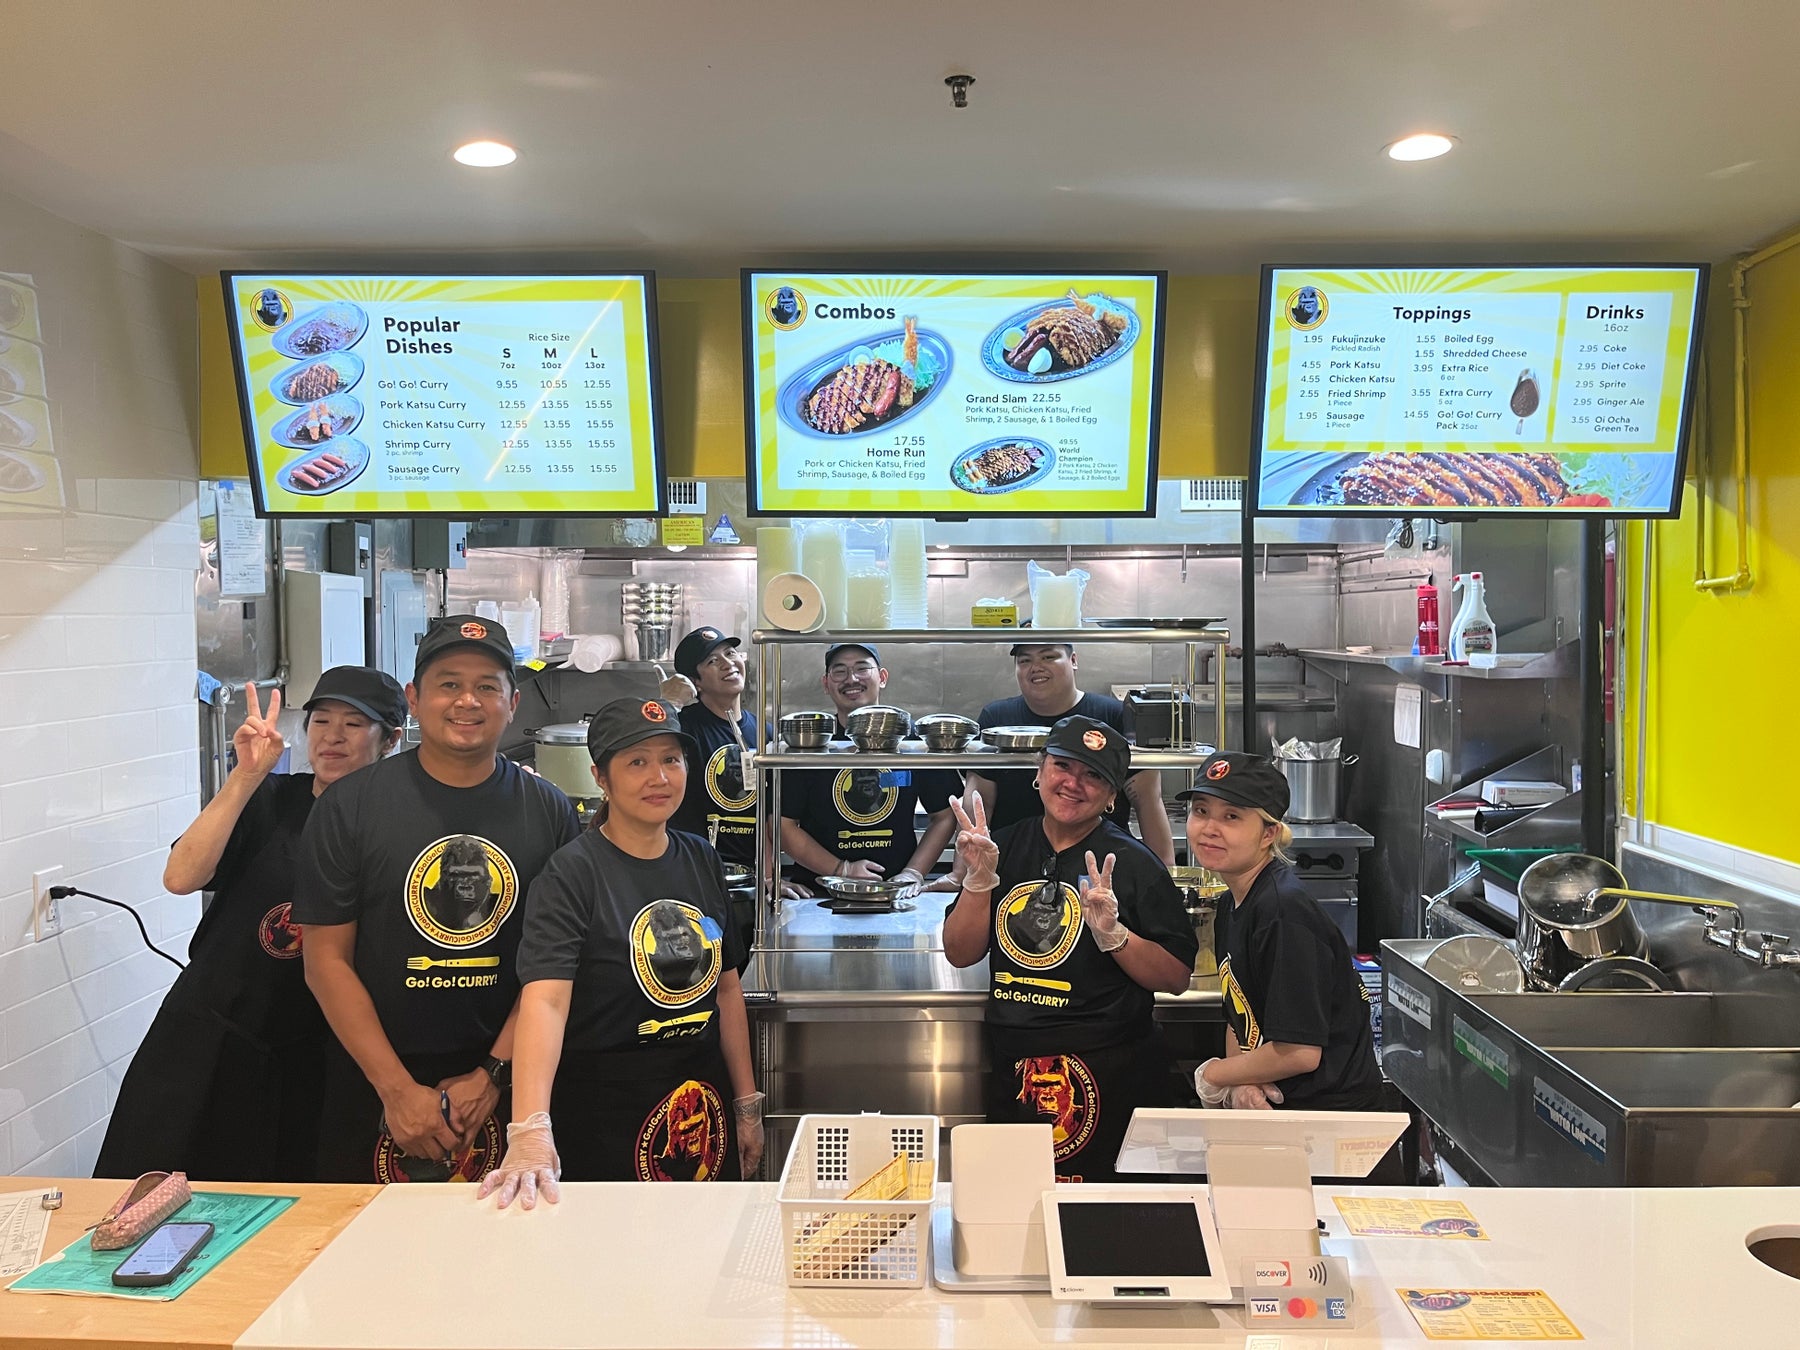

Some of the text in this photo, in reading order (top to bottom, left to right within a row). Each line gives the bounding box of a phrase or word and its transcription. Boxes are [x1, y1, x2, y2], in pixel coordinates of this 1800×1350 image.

[814, 303, 895, 319] Combos
[1393, 306, 1471, 323] Toppings
[1586, 305, 1644, 319] Drinks
[384, 316, 460, 335] Popular
[1604, 323, 1629, 332] 16oz
[528, 333, 570, 341] Rice Size
[1304, 335, 1386, 345] 1.95 Fukujinzuke
[1416, 334, 1494, 345] 1.55 Boiled Egg
[386, 338, 453, 354] Dishes
[503, 348, 598, 358] S M L
[1415, 349, 1527, 358] 1.55 Shredded Cheese
[1330, 360, 1351, 369] Pork
[1413, 364, 1433, 372] 3.95
[1468, 364, 1489, 372] Rice
[1601, 362, 1620, 370] Diet
[1300, 375, 1320, 383] 4.55
[1329, 374, 1366, 383] Chicken
[378, 380, 611, 391] Go! Go! Curry 9.55 10.55 12.55
[1575, 380, 1626, 390] 2.95 Sprite
[966, 393, 1061, 403] Grand Slam 22.55
[1300, 389, 1386, 399] 2.55 Fried Shrimp
[1411, 388, 1493, 398] 3.55 Extra Curry
[380, 400, 613, 411] Pork Katsu Curry 12.55 13.55 15.55
[1597, 398, 1627, 408] Ginger
[986, 406, 1010, 414] Katsu,
[1012, 405, 1044, 414] Chicken
[1045, 406, 1070, 414] Katsu,
[1082, 415, 1098, 425] Egg
[1326, 412, 1365, 422] Sausage
[1404, 410, 1502, 420] 14.55 Go! Go! Curry
[382, 420, 614, 430] Chicken Katsu Curry 12.55 13.55 15.55
[1436, 421, 1458, 430] Pack
[385, 439, 615, 450] Shrimp Curry 12.55 13.55 15.55
[894, 436, 925, 446] 17.55
[867, 448, 925, 457] Home Run
[805, 459, 824, 468] Pork
[838, 459, 873, 468] Chicken
[875, 460, 902, 469] Katsu,
[903, 460, 926, 468] Fried
[388, 464, 617, 475] Sausage Curry 12.55 13.55 15.55
[797, 469, 830, 479] Shrimp,
[831, 470, 869, 480] Sausage,
[880, 470, 907, 479] Boiled
[908, 471, 926, 480] Egg
[406, 974, 497, 988] Go! Go! CURRY!
[994, 989, 1012, 1000] Go!
[1013, 991, 1030, 1002] Go!
[1256, 1304, 1277, 1312] VISA
